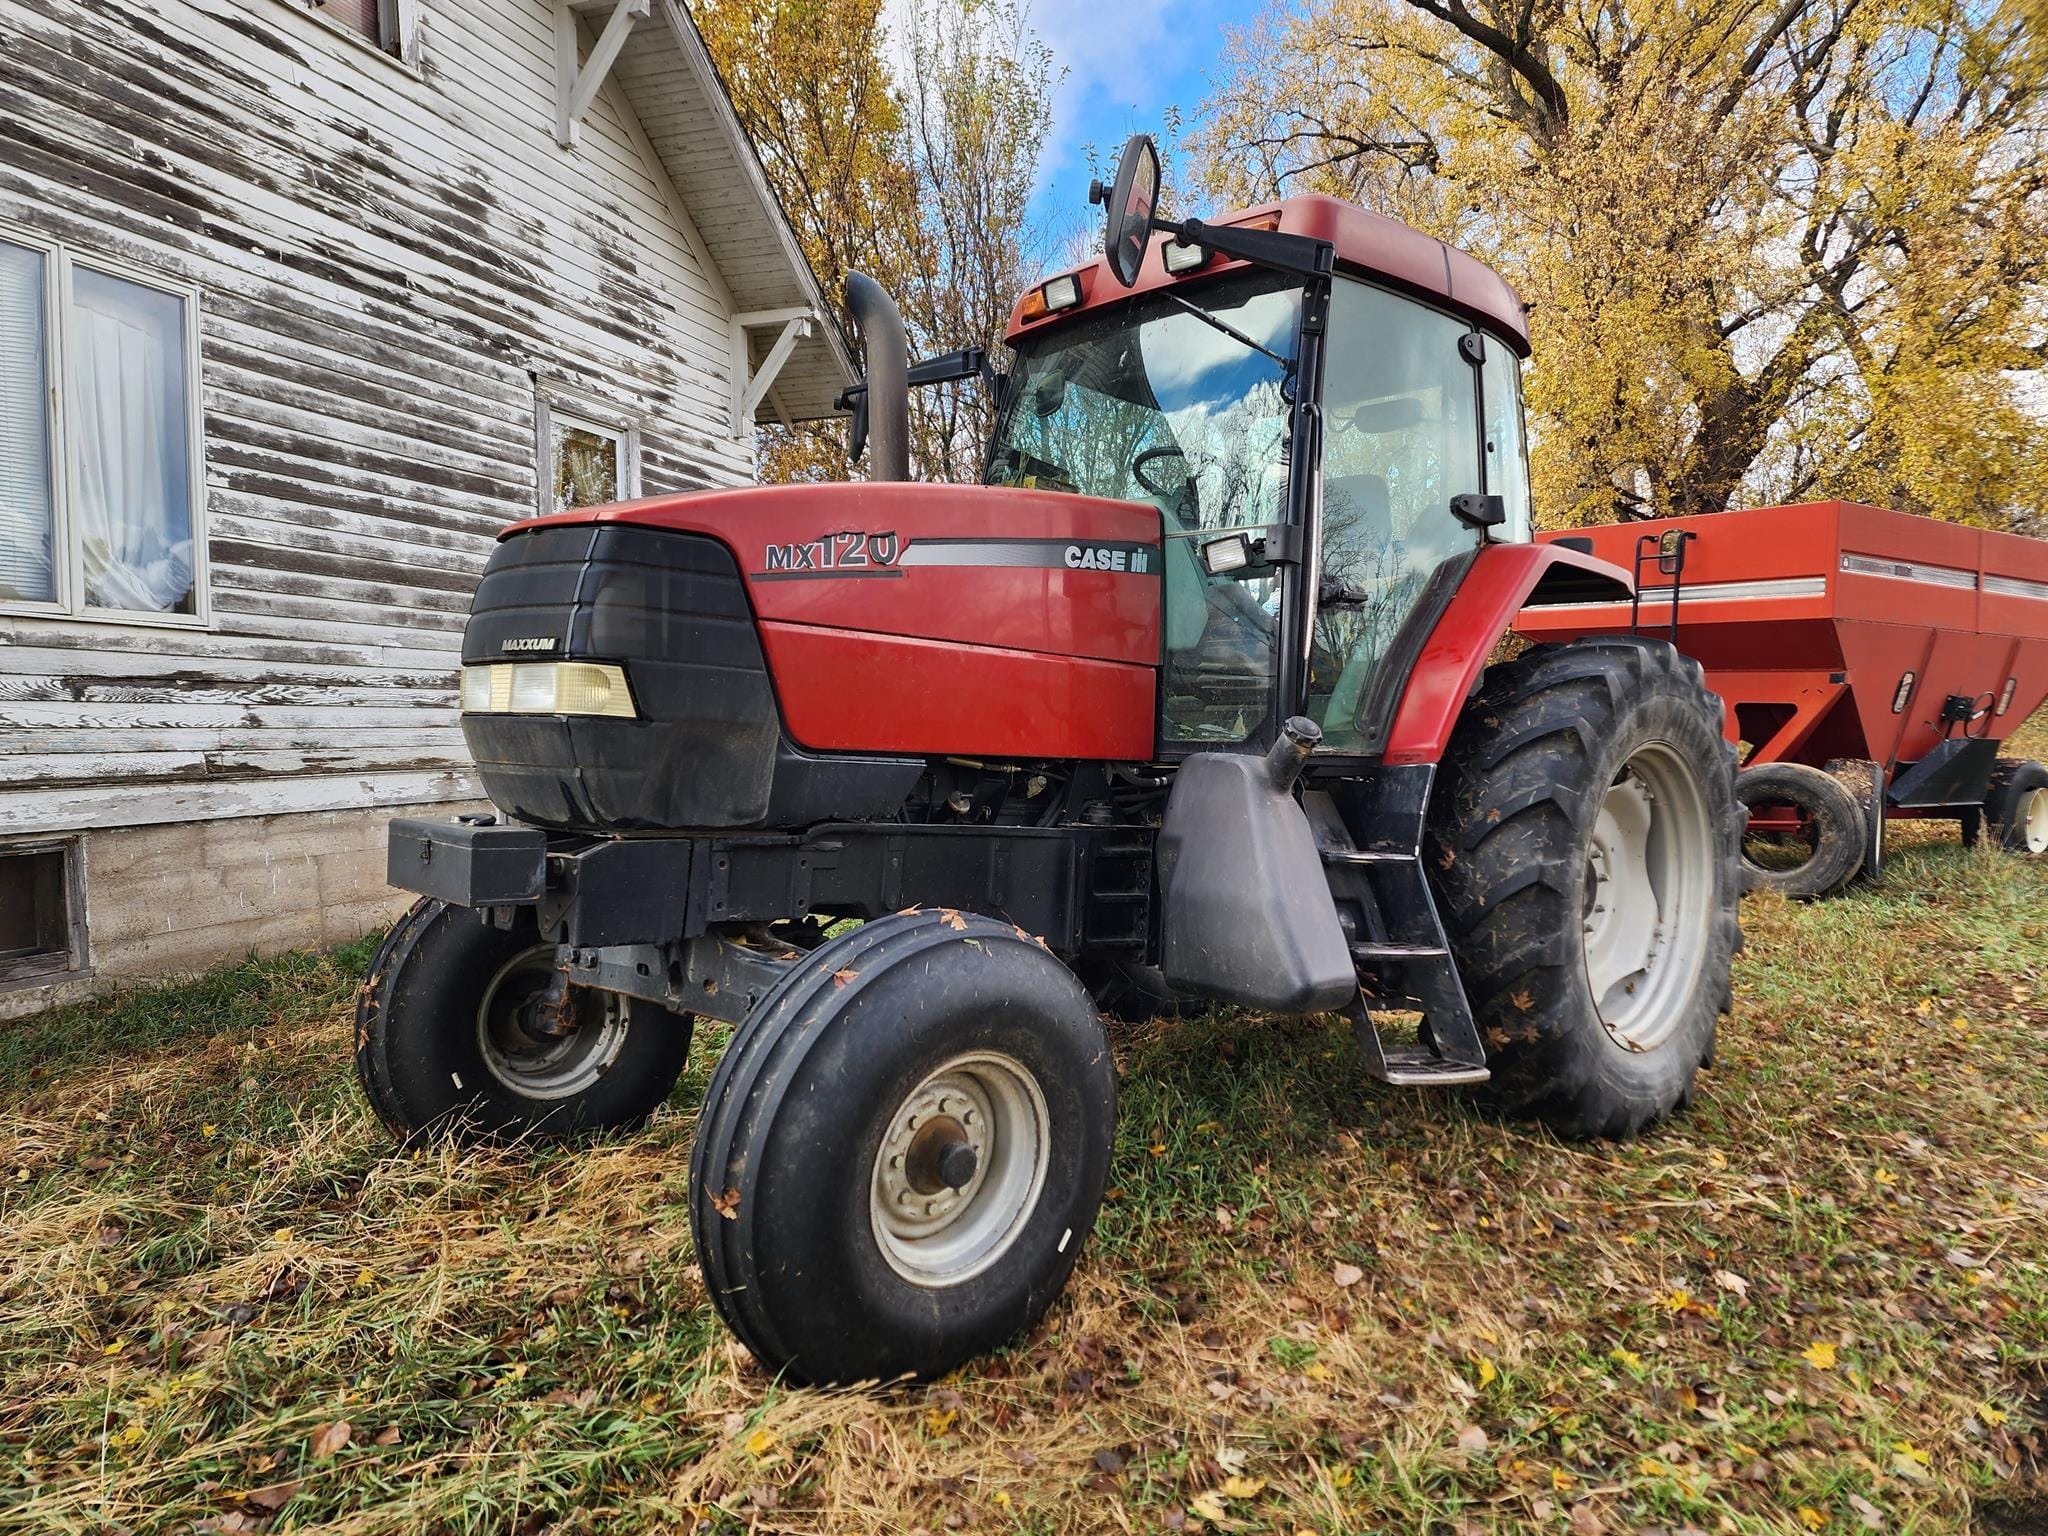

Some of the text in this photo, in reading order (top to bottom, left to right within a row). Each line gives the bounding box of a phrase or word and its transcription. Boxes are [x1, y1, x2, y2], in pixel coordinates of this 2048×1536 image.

[765, 531, 898, 570] MX120
[1064, 545, 1126, 571] CASE
[501, 638, 555, 651] MAXXUM
